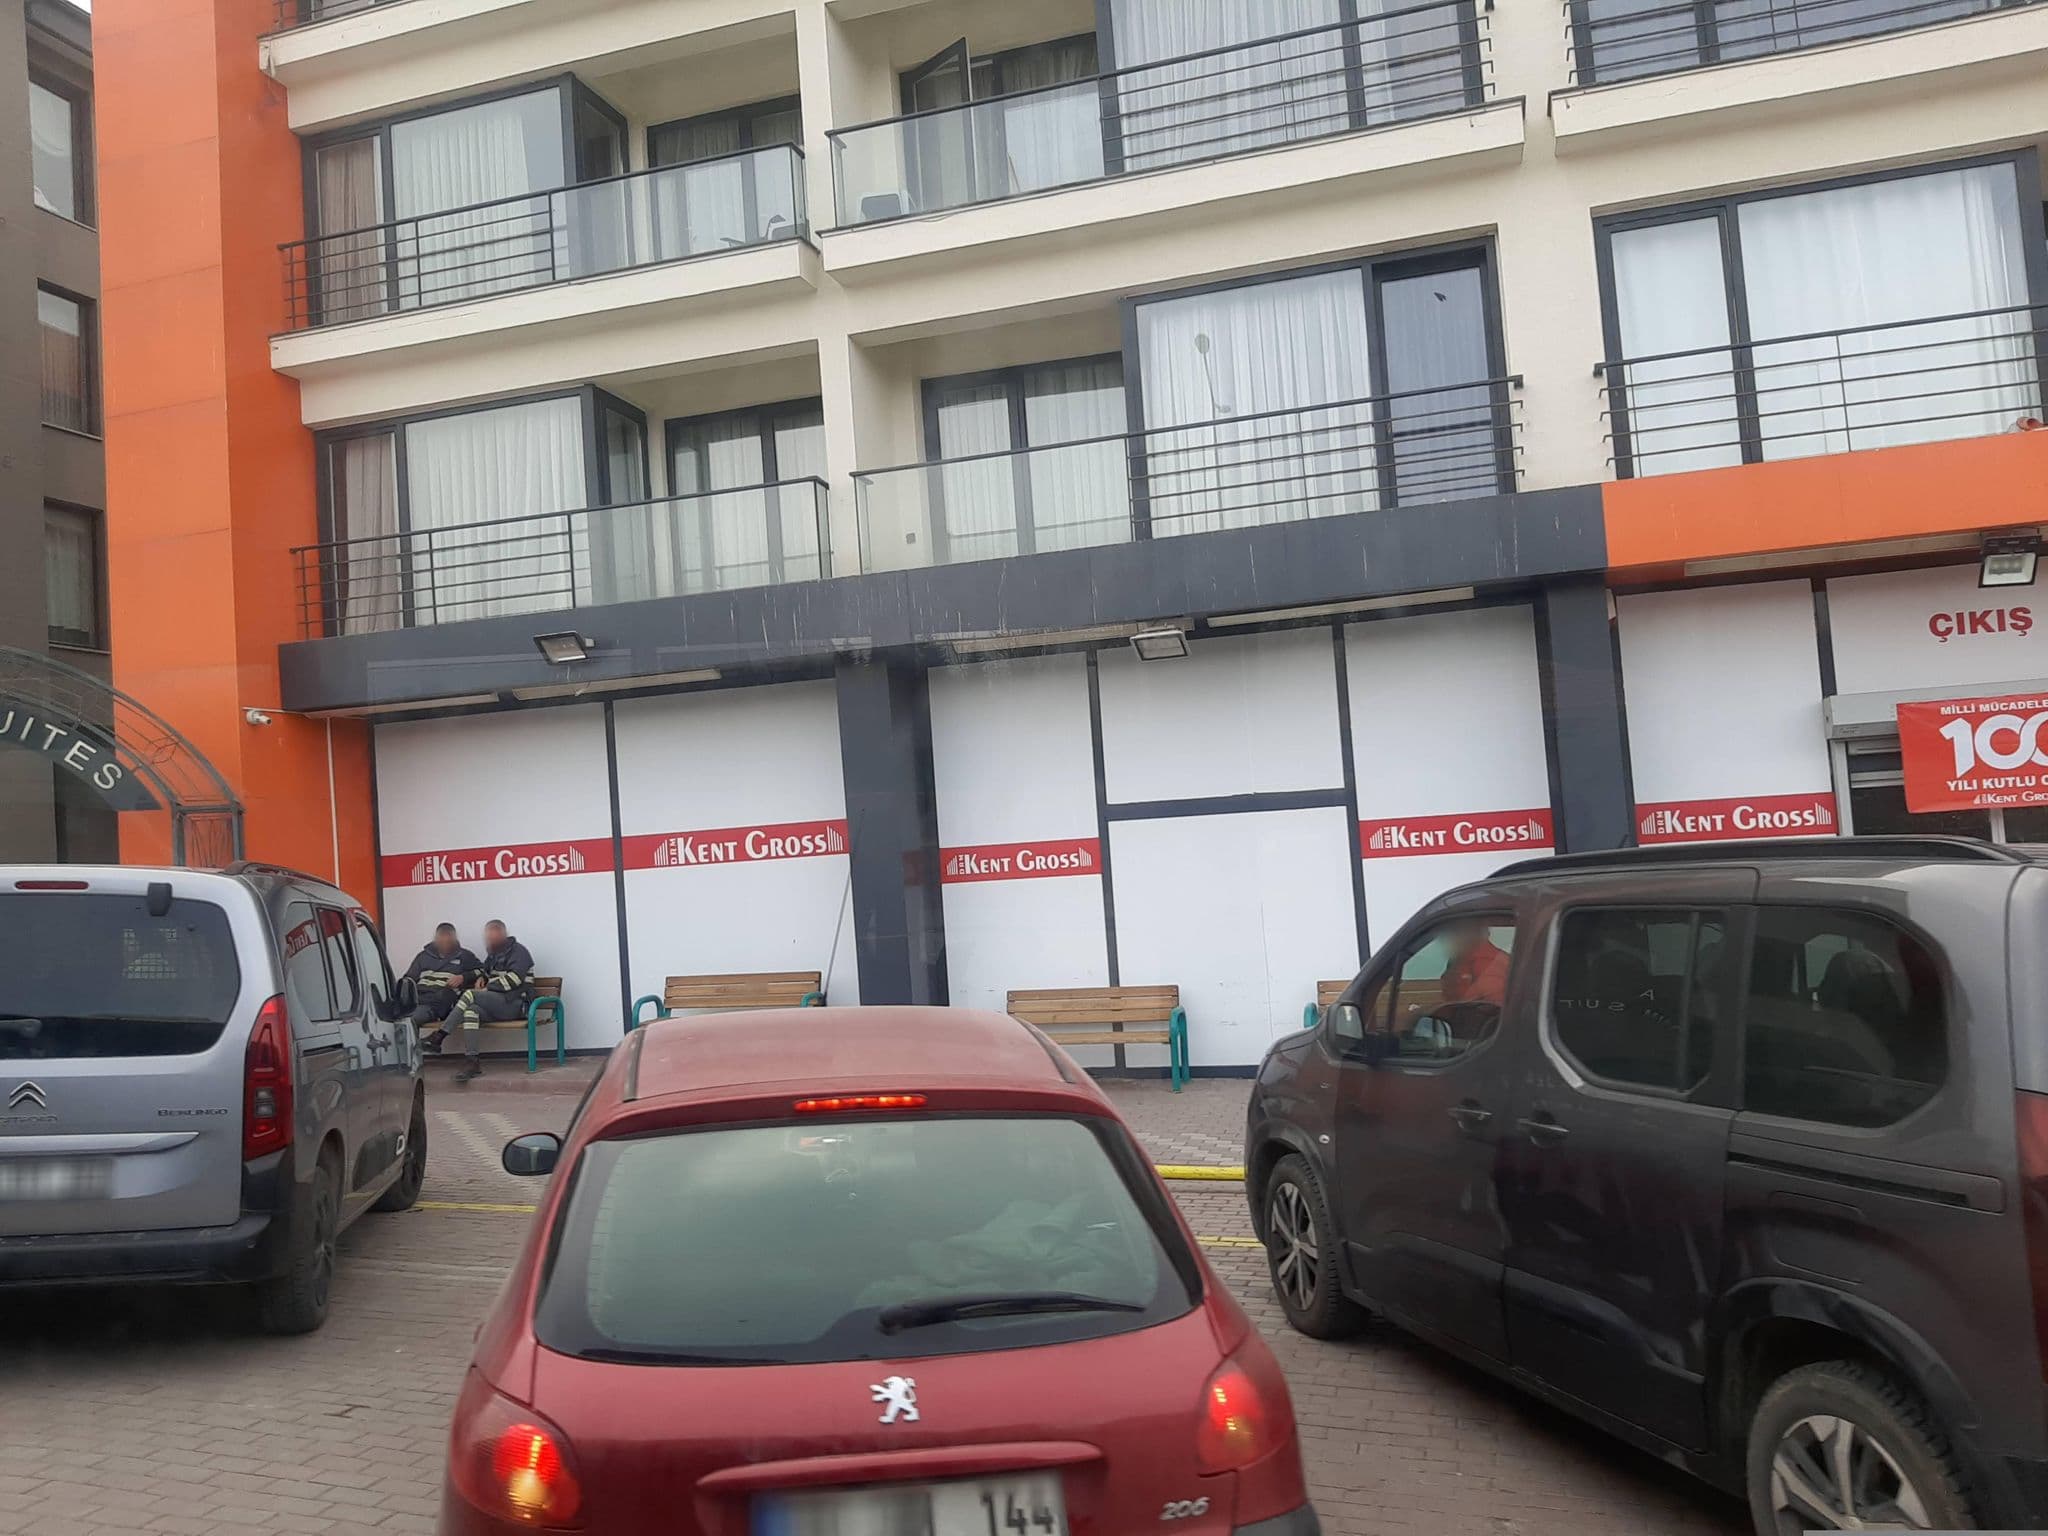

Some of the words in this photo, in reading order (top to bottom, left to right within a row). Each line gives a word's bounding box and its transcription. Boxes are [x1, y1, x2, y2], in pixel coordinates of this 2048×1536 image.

[1928, 606, 2033, 643] ÇIKIŞ
[1940, 703, 1975, 715] MİLLİ
[1946, 779, 1978, 791] YILI
[1982, 775, 2036, 789] KUTLU
[1987, 793, 2018, 804] KENT
[1664, 810, 1725, 834] KENT
[1732, 805, 1816, 830] GROSS
[677, 836, 738, 865] KENT
[744, 830, 828, 860] GROSS
[1391, 825, 1447, 849] KENT
[1453, 821, 1529, 845] GROSS
[433, 855, 488, 882] KENT
[494, 849, 570, 878] GROSS
[964, 853, 1011, 875] KENT
[1016, 849, 1079, 872] GROSS
[1158, 1496, 1211, 1520] 206
